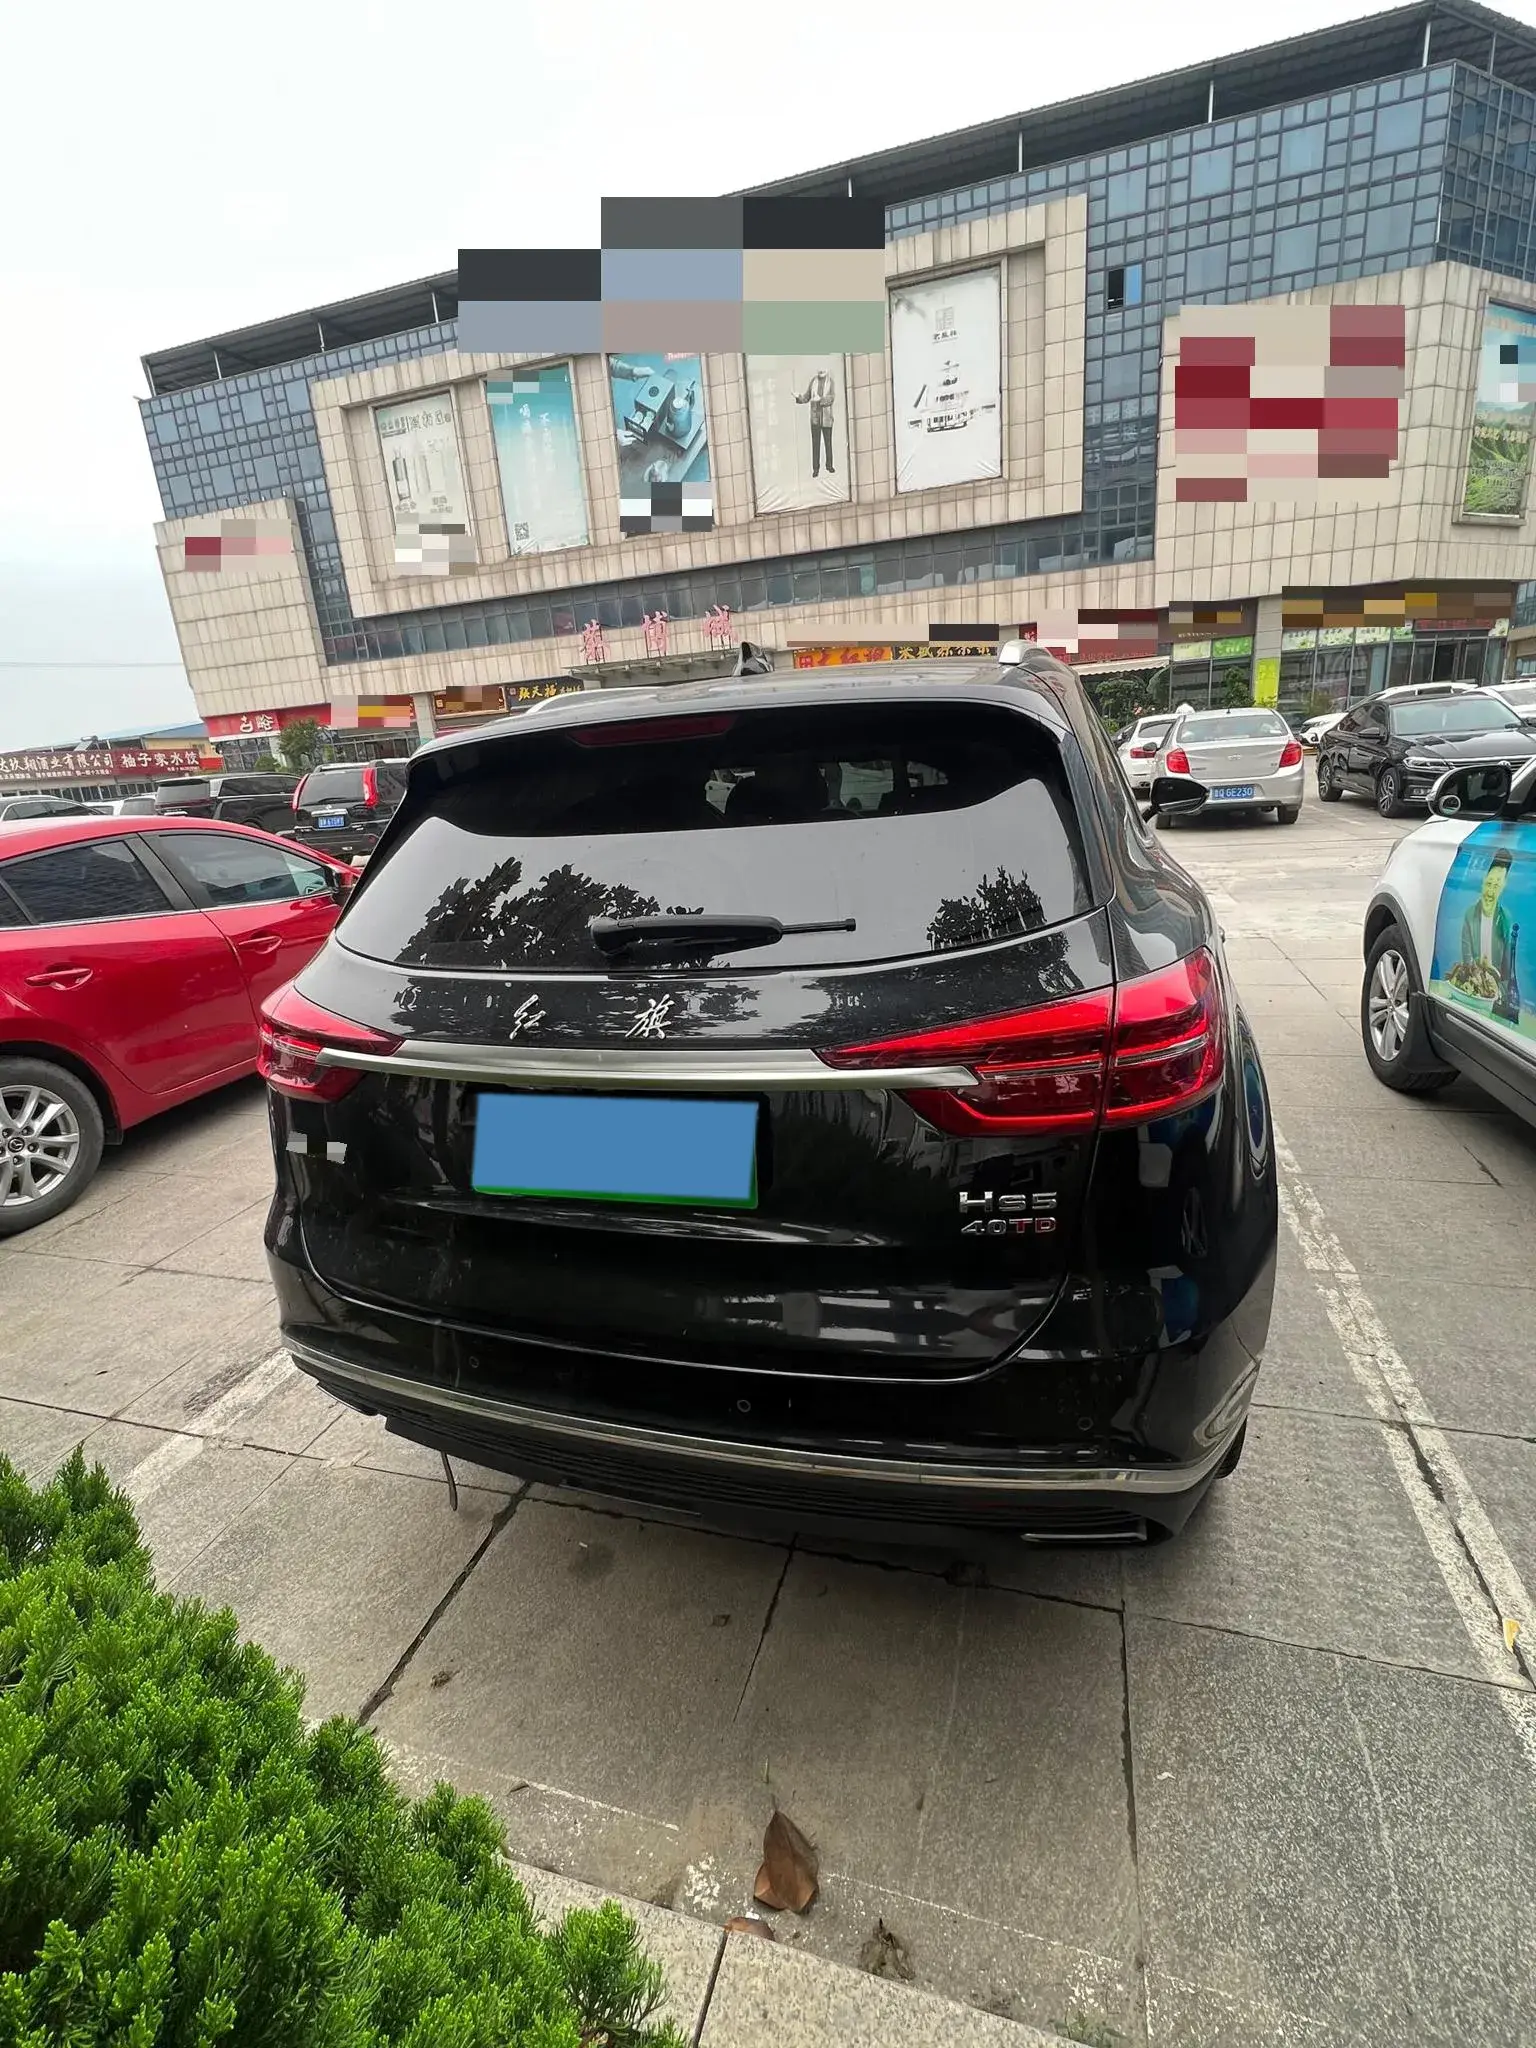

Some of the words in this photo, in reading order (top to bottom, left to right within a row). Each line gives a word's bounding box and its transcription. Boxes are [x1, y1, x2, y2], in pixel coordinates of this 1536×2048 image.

[121, 751, 199, 768] 柚子家水饺
[509, 994, 675, 1040] 红旗
[959, 1191, 1057, 1213] HS5
[960, 1217, 1057, 1235] 40TD
